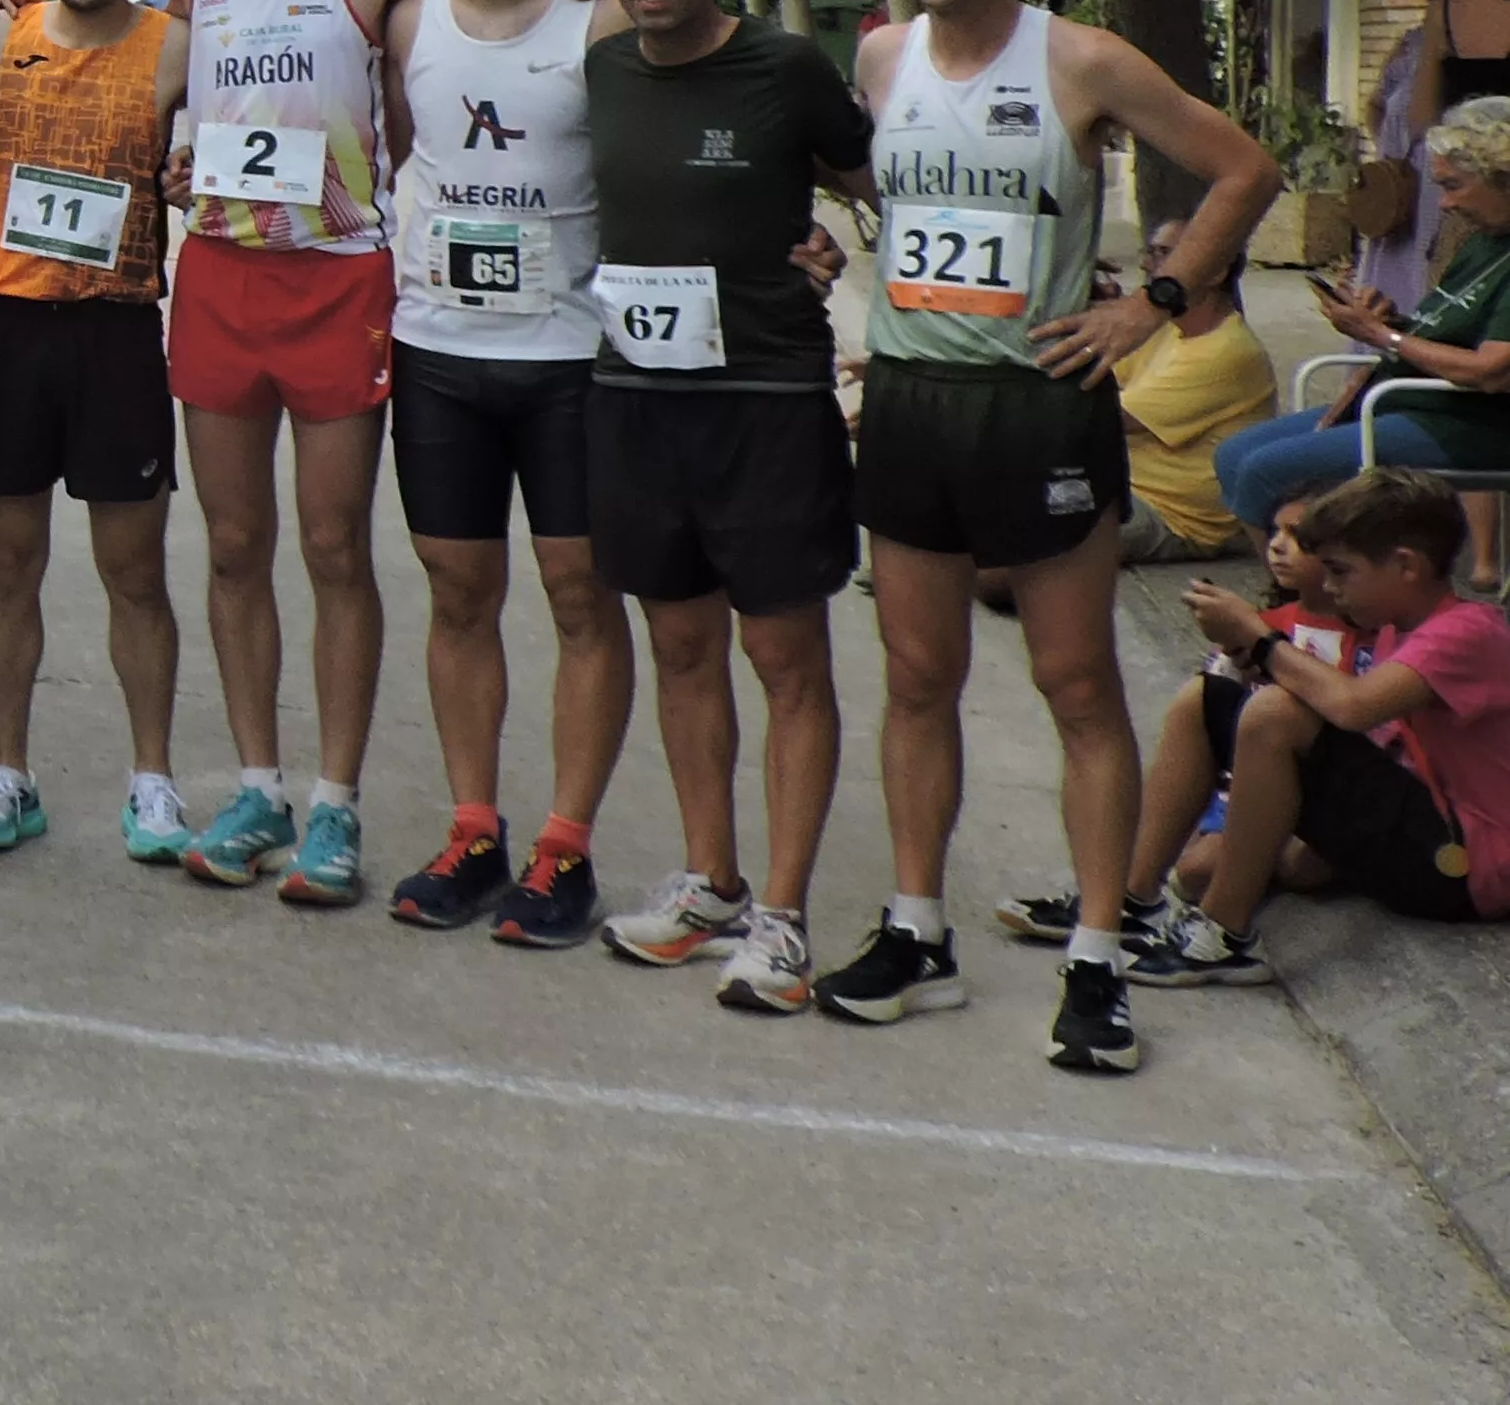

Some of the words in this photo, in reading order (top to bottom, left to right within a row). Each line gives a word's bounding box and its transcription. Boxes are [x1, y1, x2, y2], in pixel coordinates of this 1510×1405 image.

[242, 130, 278, 177] 2
[37, 193, 83, 232] 11
[439, 183, 547, 209] ALEGRÍA
[471, 252, 516, 286] 65
[898, 229, 1011, 287] 321
[624, 304, 679, 341] 67
